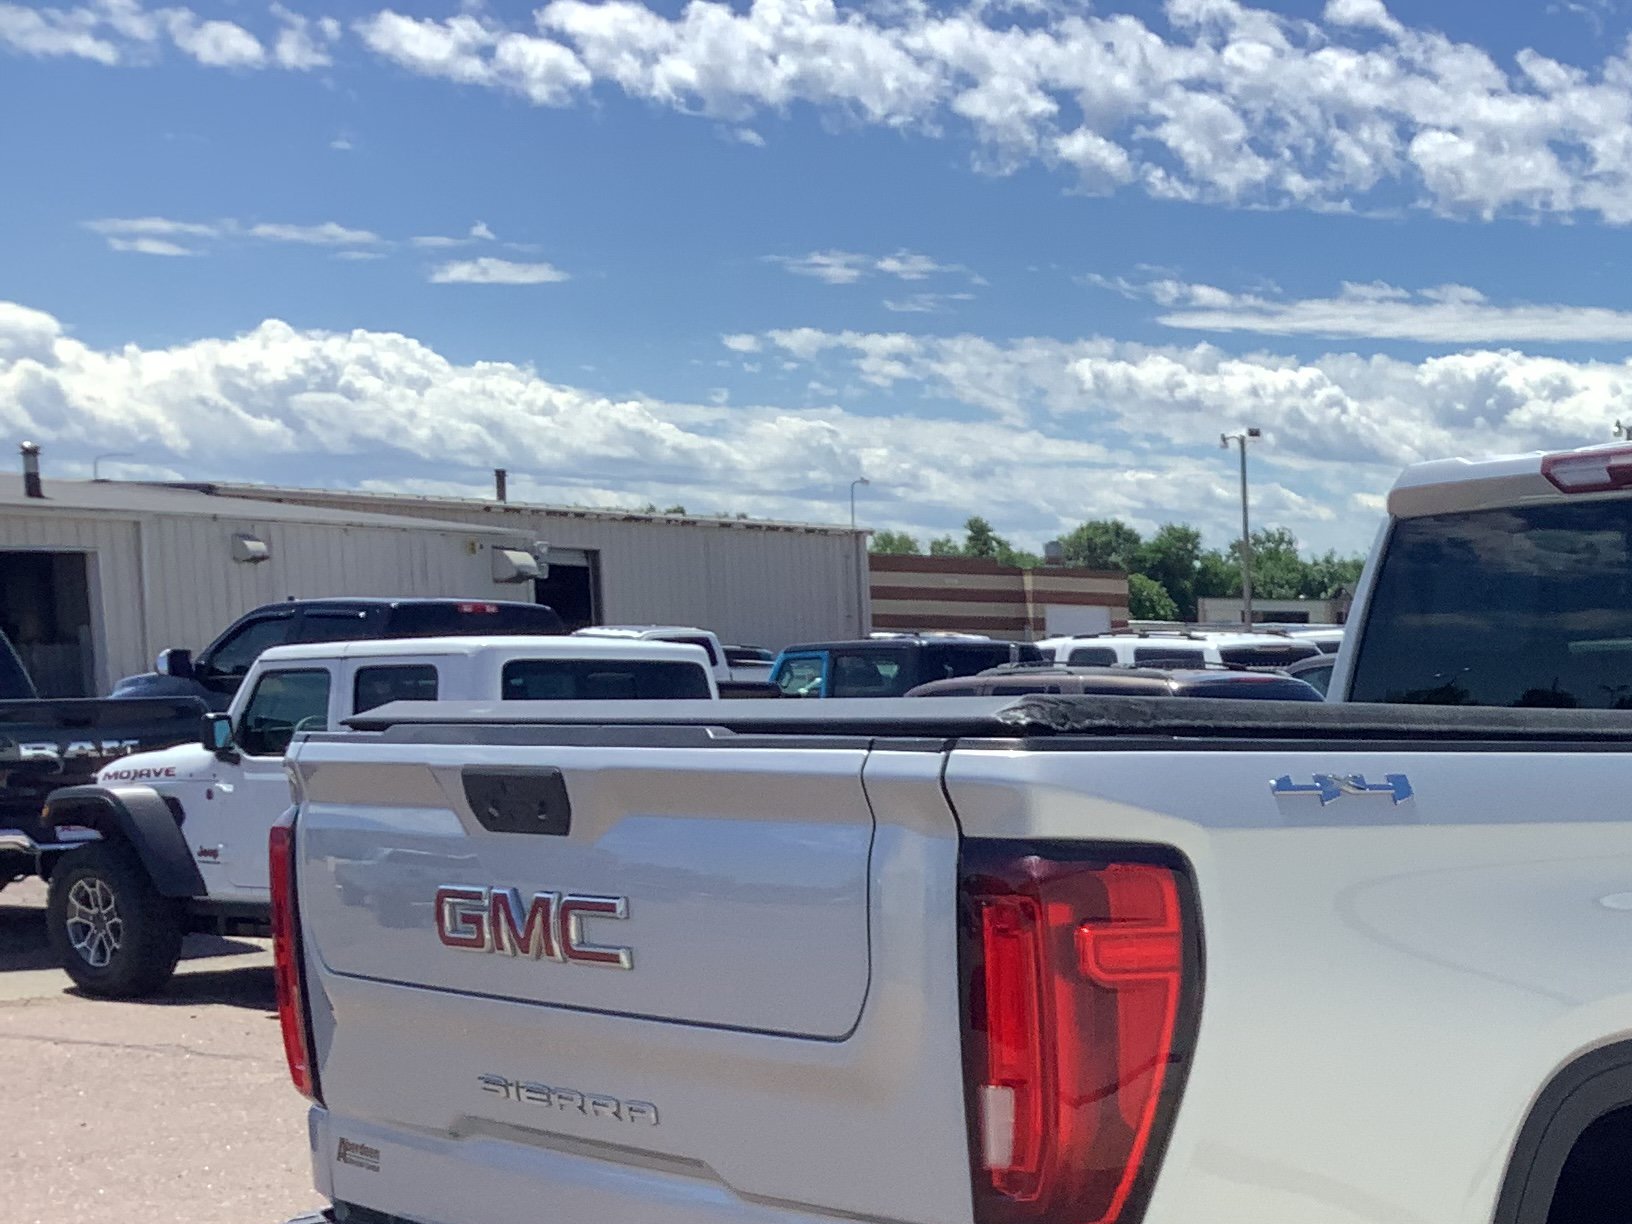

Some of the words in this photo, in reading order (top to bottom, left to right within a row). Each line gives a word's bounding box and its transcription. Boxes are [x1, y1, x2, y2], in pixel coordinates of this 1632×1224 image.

[102, 766, 176, 781] MOJAVE
[434, 884, 634, 971] GMC
[477, 1073, 660, 1126] SIERRA
